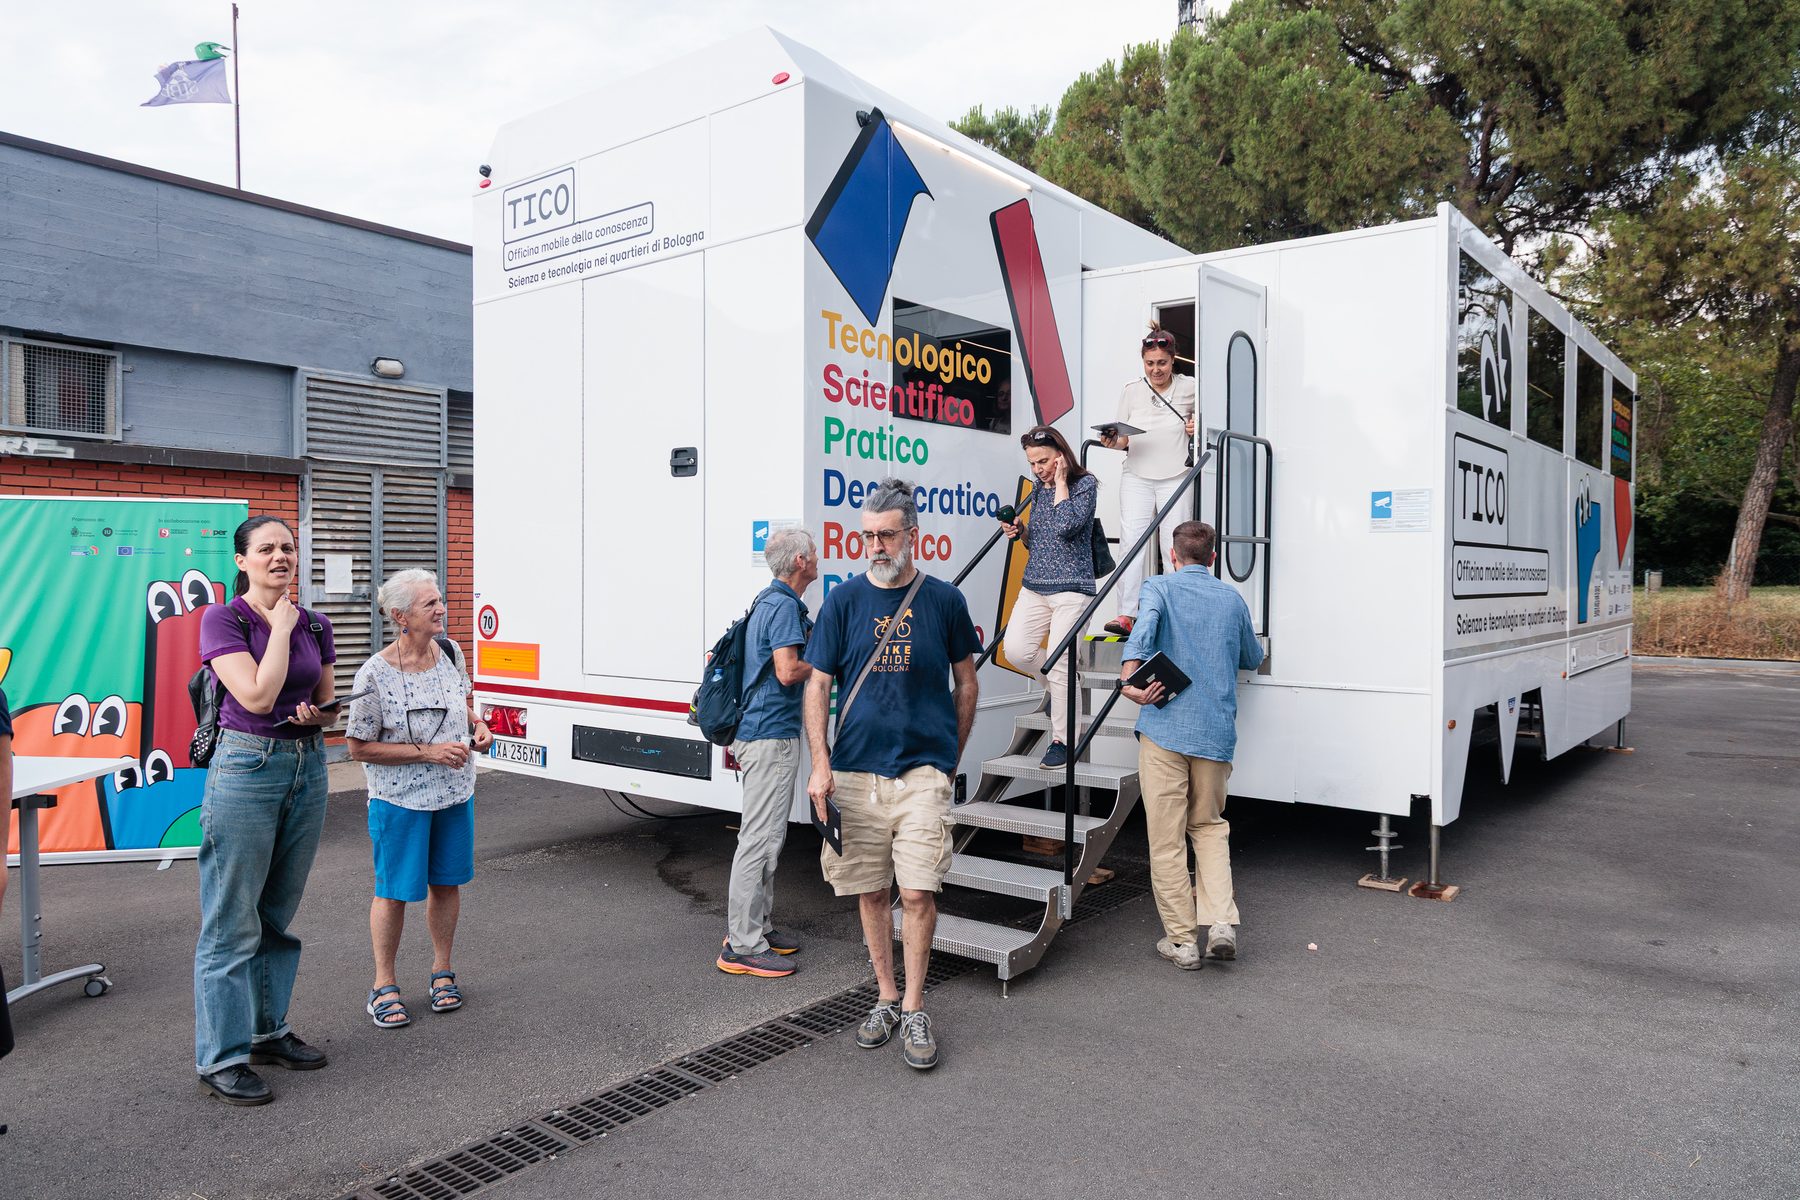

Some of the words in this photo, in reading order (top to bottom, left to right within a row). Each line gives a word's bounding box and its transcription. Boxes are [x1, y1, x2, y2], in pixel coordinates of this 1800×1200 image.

[507, 183, 570, 229] TICO
[507, 245, 540, 262] Officina
[541, 235, 570, 253] mobile
[571, 229, 593, 244] della
[595, 215, 648, 238] conoscenza
[508, 273, 539, 289] Scienza
[540, 271, 546, 280] e
[548, 258, 592, 278] tecnologia
[594, 253, 608, 267] nei
[609, 241, 650, 265] quartieri
[651, 239, 661, 253] di
[663, 230, 705, 250] Bologna
[821, 309, 992, 385] Tecnologico
[823, 363, 975, 426] Scientifico
[824, 415, 929, 466] Pratico
[823, 468, 1000, 518] Decratico
[1458, 459, 1506, 525] TICO
[823, 521, 952, 561] Roico
[1456, 559, 1484, 581] Officina
[483, 615, 493, 630] 70
[1456, 613, 1483, 635] Scienza
[1488, 609, 1518, 632] tecnologia
[872, 664, 911, 673] BOLOGNA
[876, 645, 912, 655] IKE
